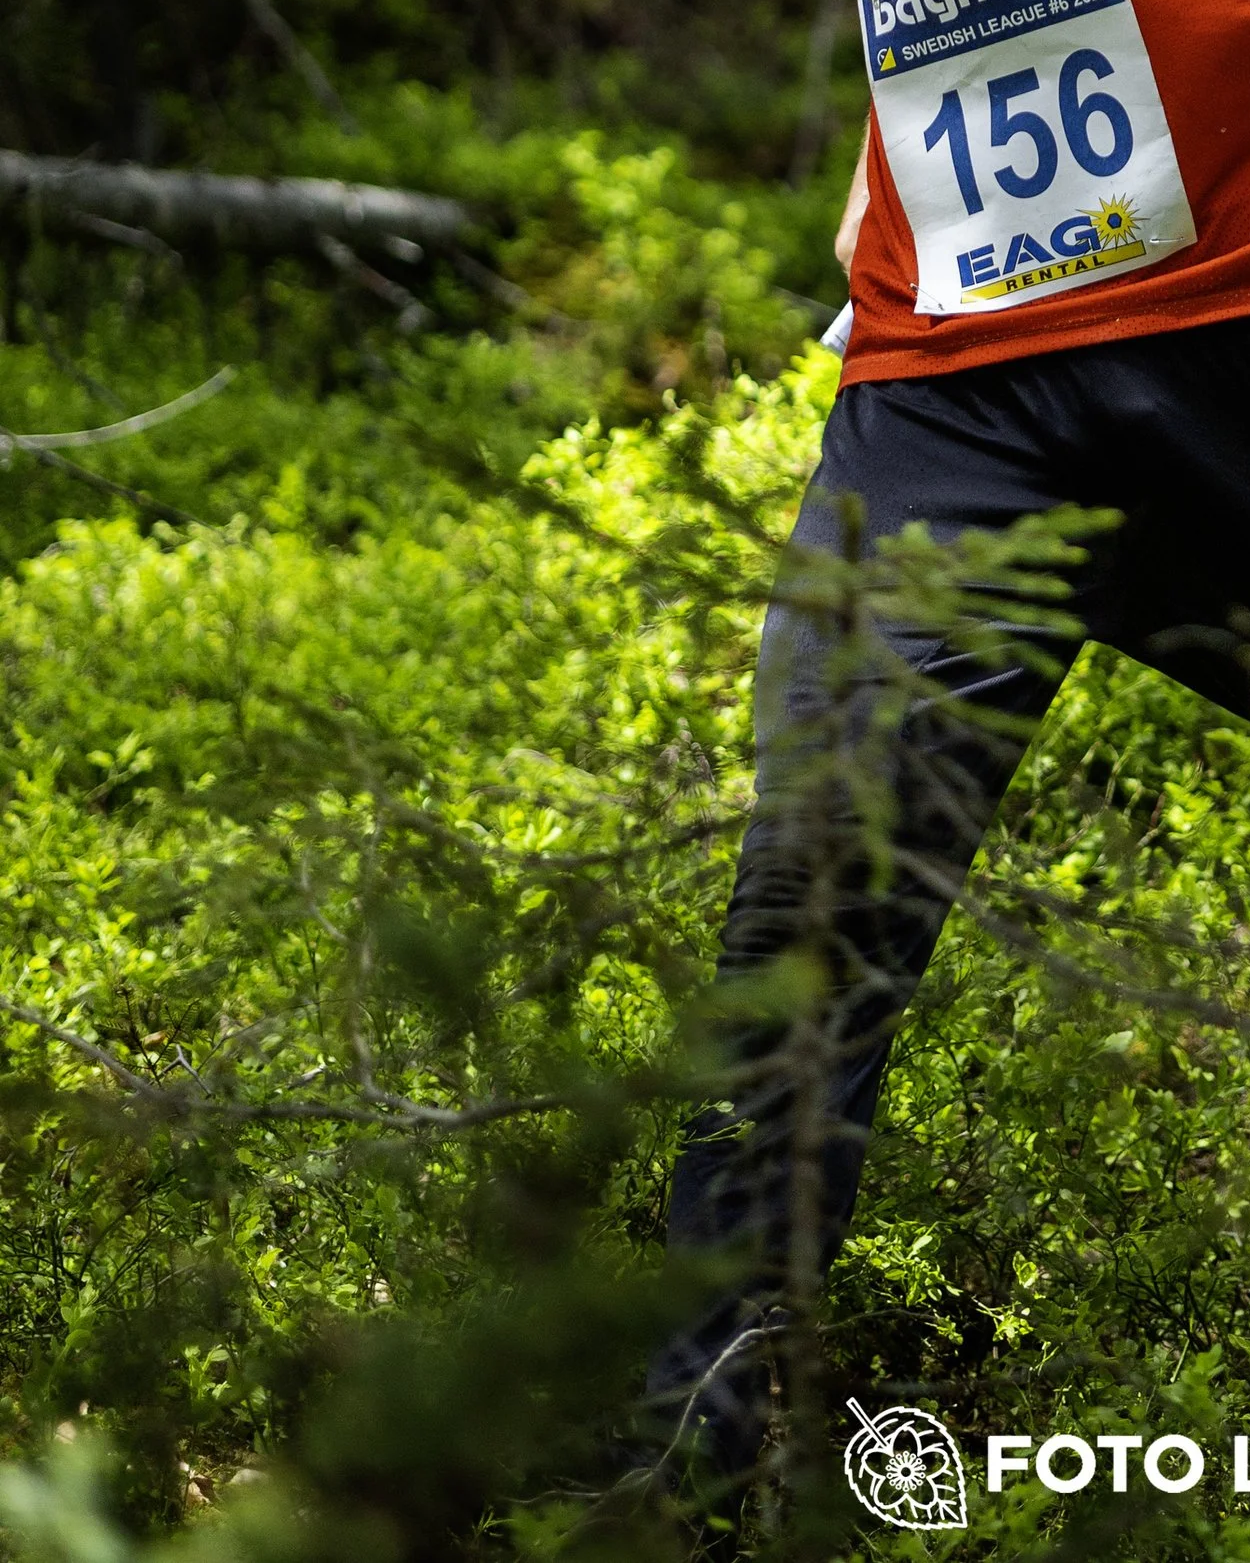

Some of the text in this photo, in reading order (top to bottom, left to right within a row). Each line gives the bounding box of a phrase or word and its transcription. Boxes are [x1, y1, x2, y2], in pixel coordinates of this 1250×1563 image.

[901, 25, 976, 61] SWEDISH
[980, 3, 1047, 37] LEAGUE
[923, 48, 1134, 216] 156
[1005, 253, 1105, 292] RENTAL
